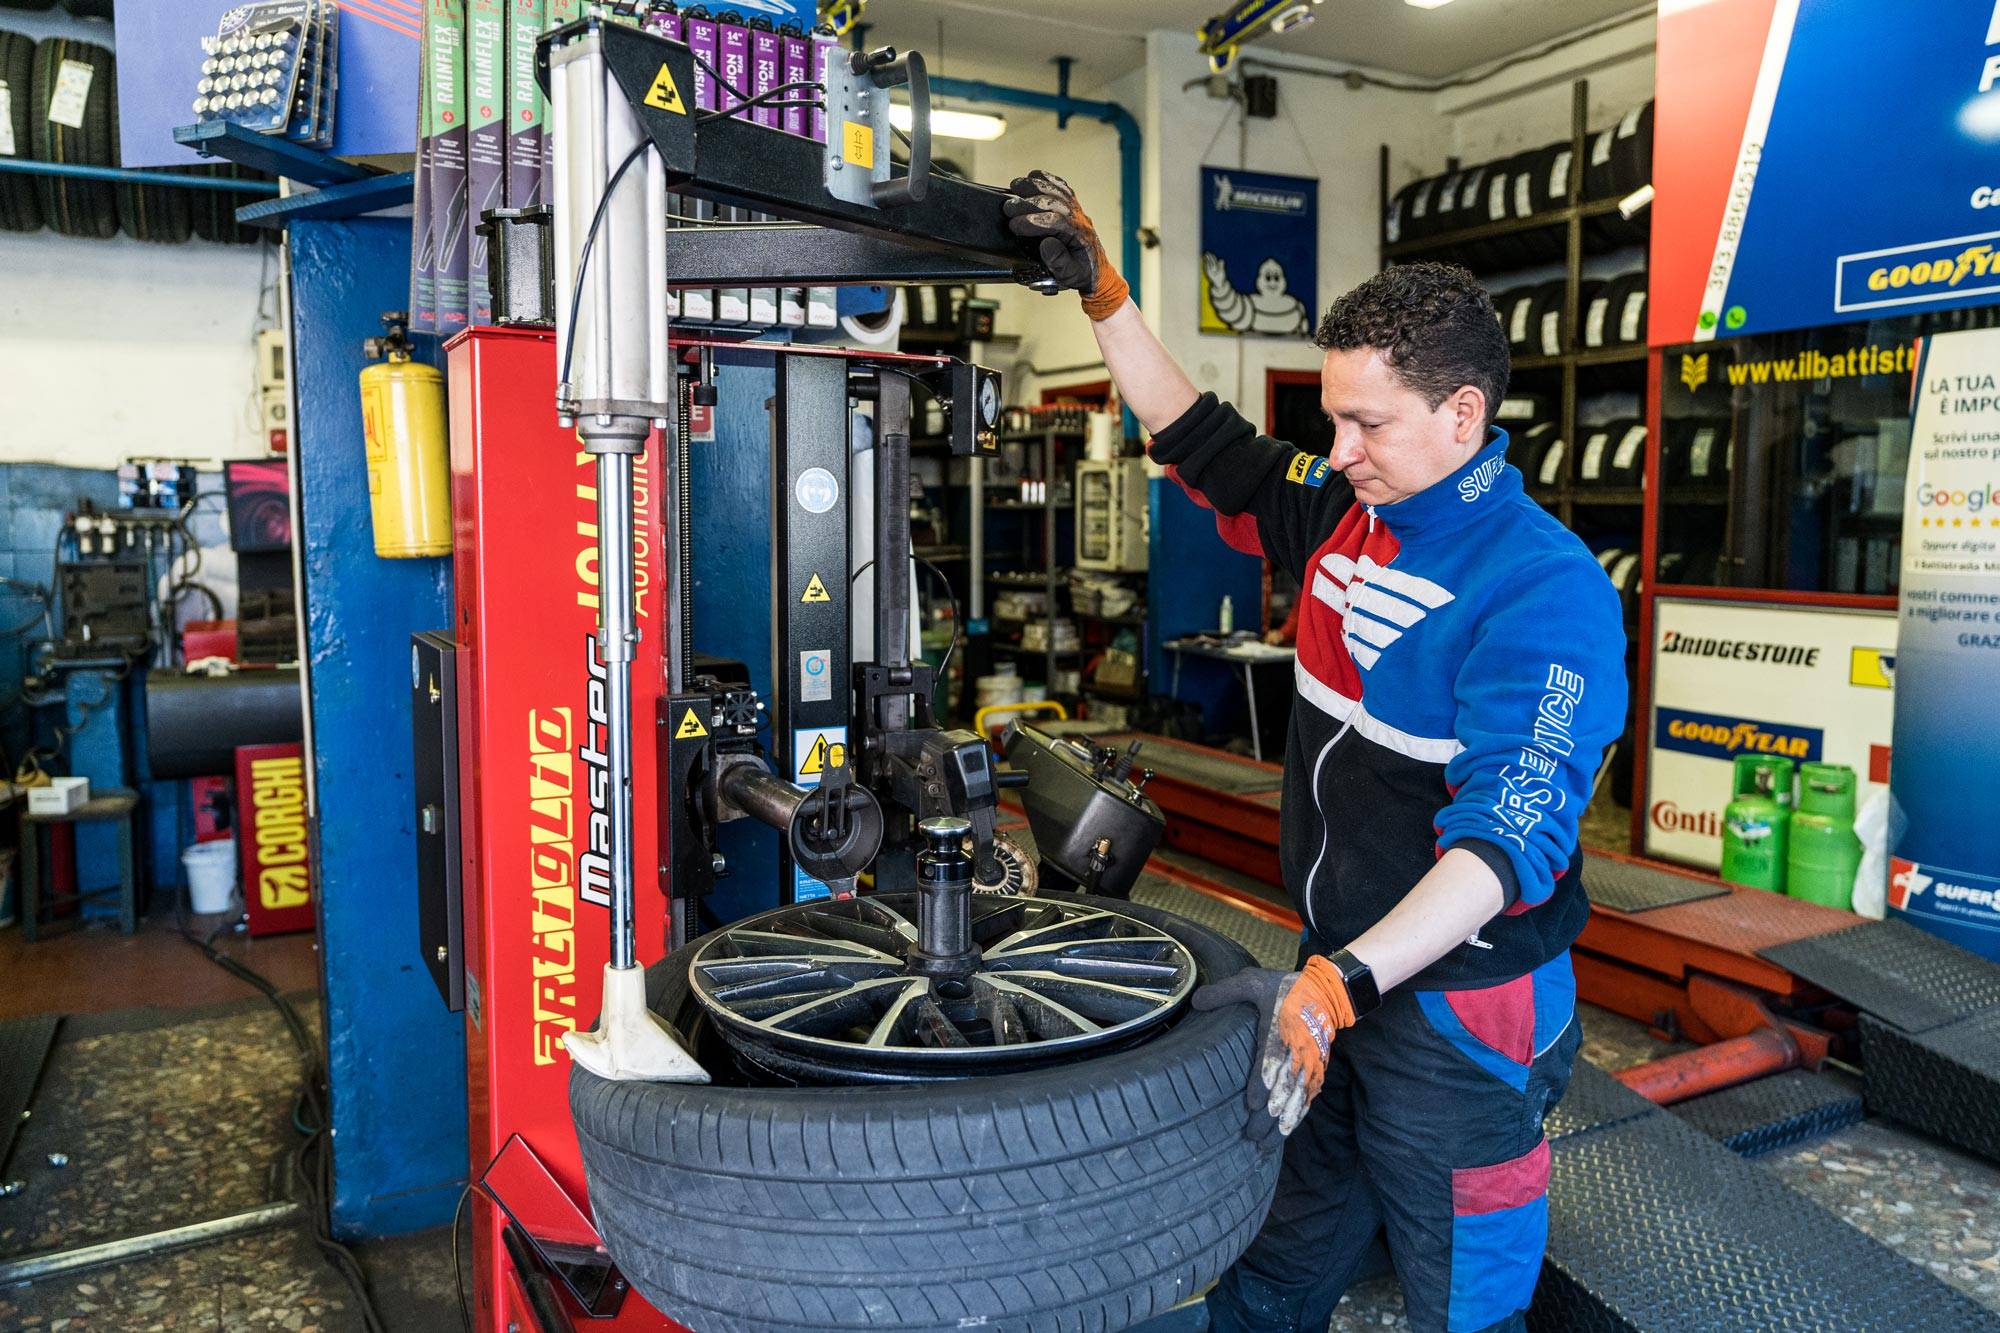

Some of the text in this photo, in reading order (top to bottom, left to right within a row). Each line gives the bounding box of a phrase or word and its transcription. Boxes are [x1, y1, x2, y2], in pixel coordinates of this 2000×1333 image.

[435, 24, 453, 104] RAINFLEX
[475, 18, 492, 99] RAINFLEX
[516, 22, 533, 103] RAINFLEX
[1930, 374, 1995, 394] LA TUA
[1942, 447, 1988, 459] nostro
[1917, 481, 2000, 512] Google
[1661, 630, 1820, 667] BRIDGESTONE
[1668, 719, 1810, 757] GOODYEAR
[251, 757, 308, 865] CORGHI
